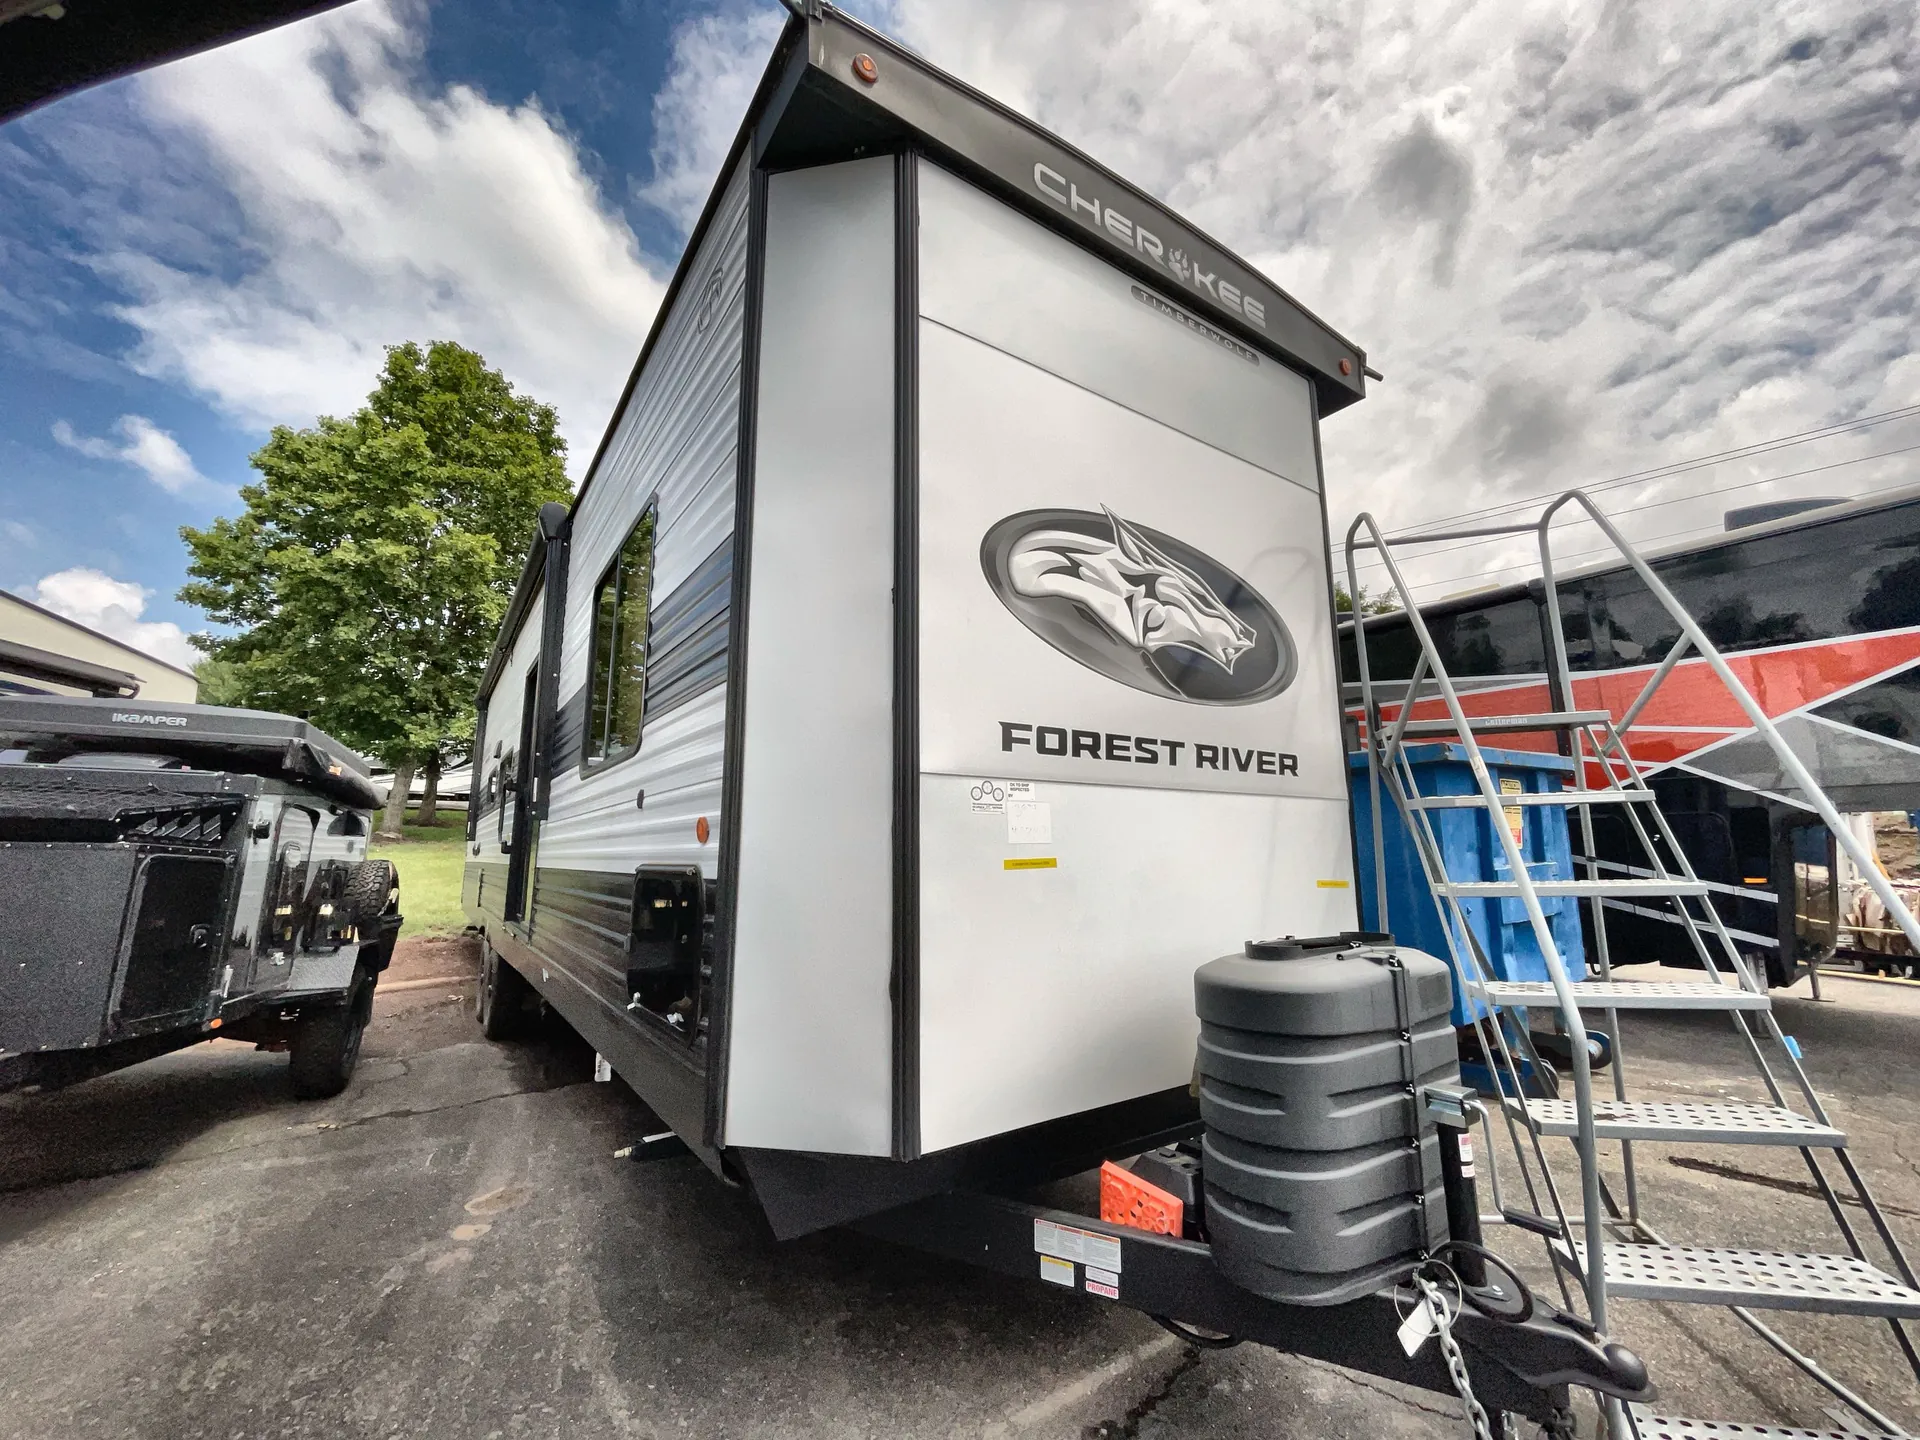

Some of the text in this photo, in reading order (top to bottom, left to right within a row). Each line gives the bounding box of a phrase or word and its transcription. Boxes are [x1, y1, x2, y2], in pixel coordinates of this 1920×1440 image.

[1140, 291, 1253, 361] TIMBERWOLF
[998, 720, 1299, 777] FOREST RIVER
[1087, 1282, 1118, 1297] PROPANE
